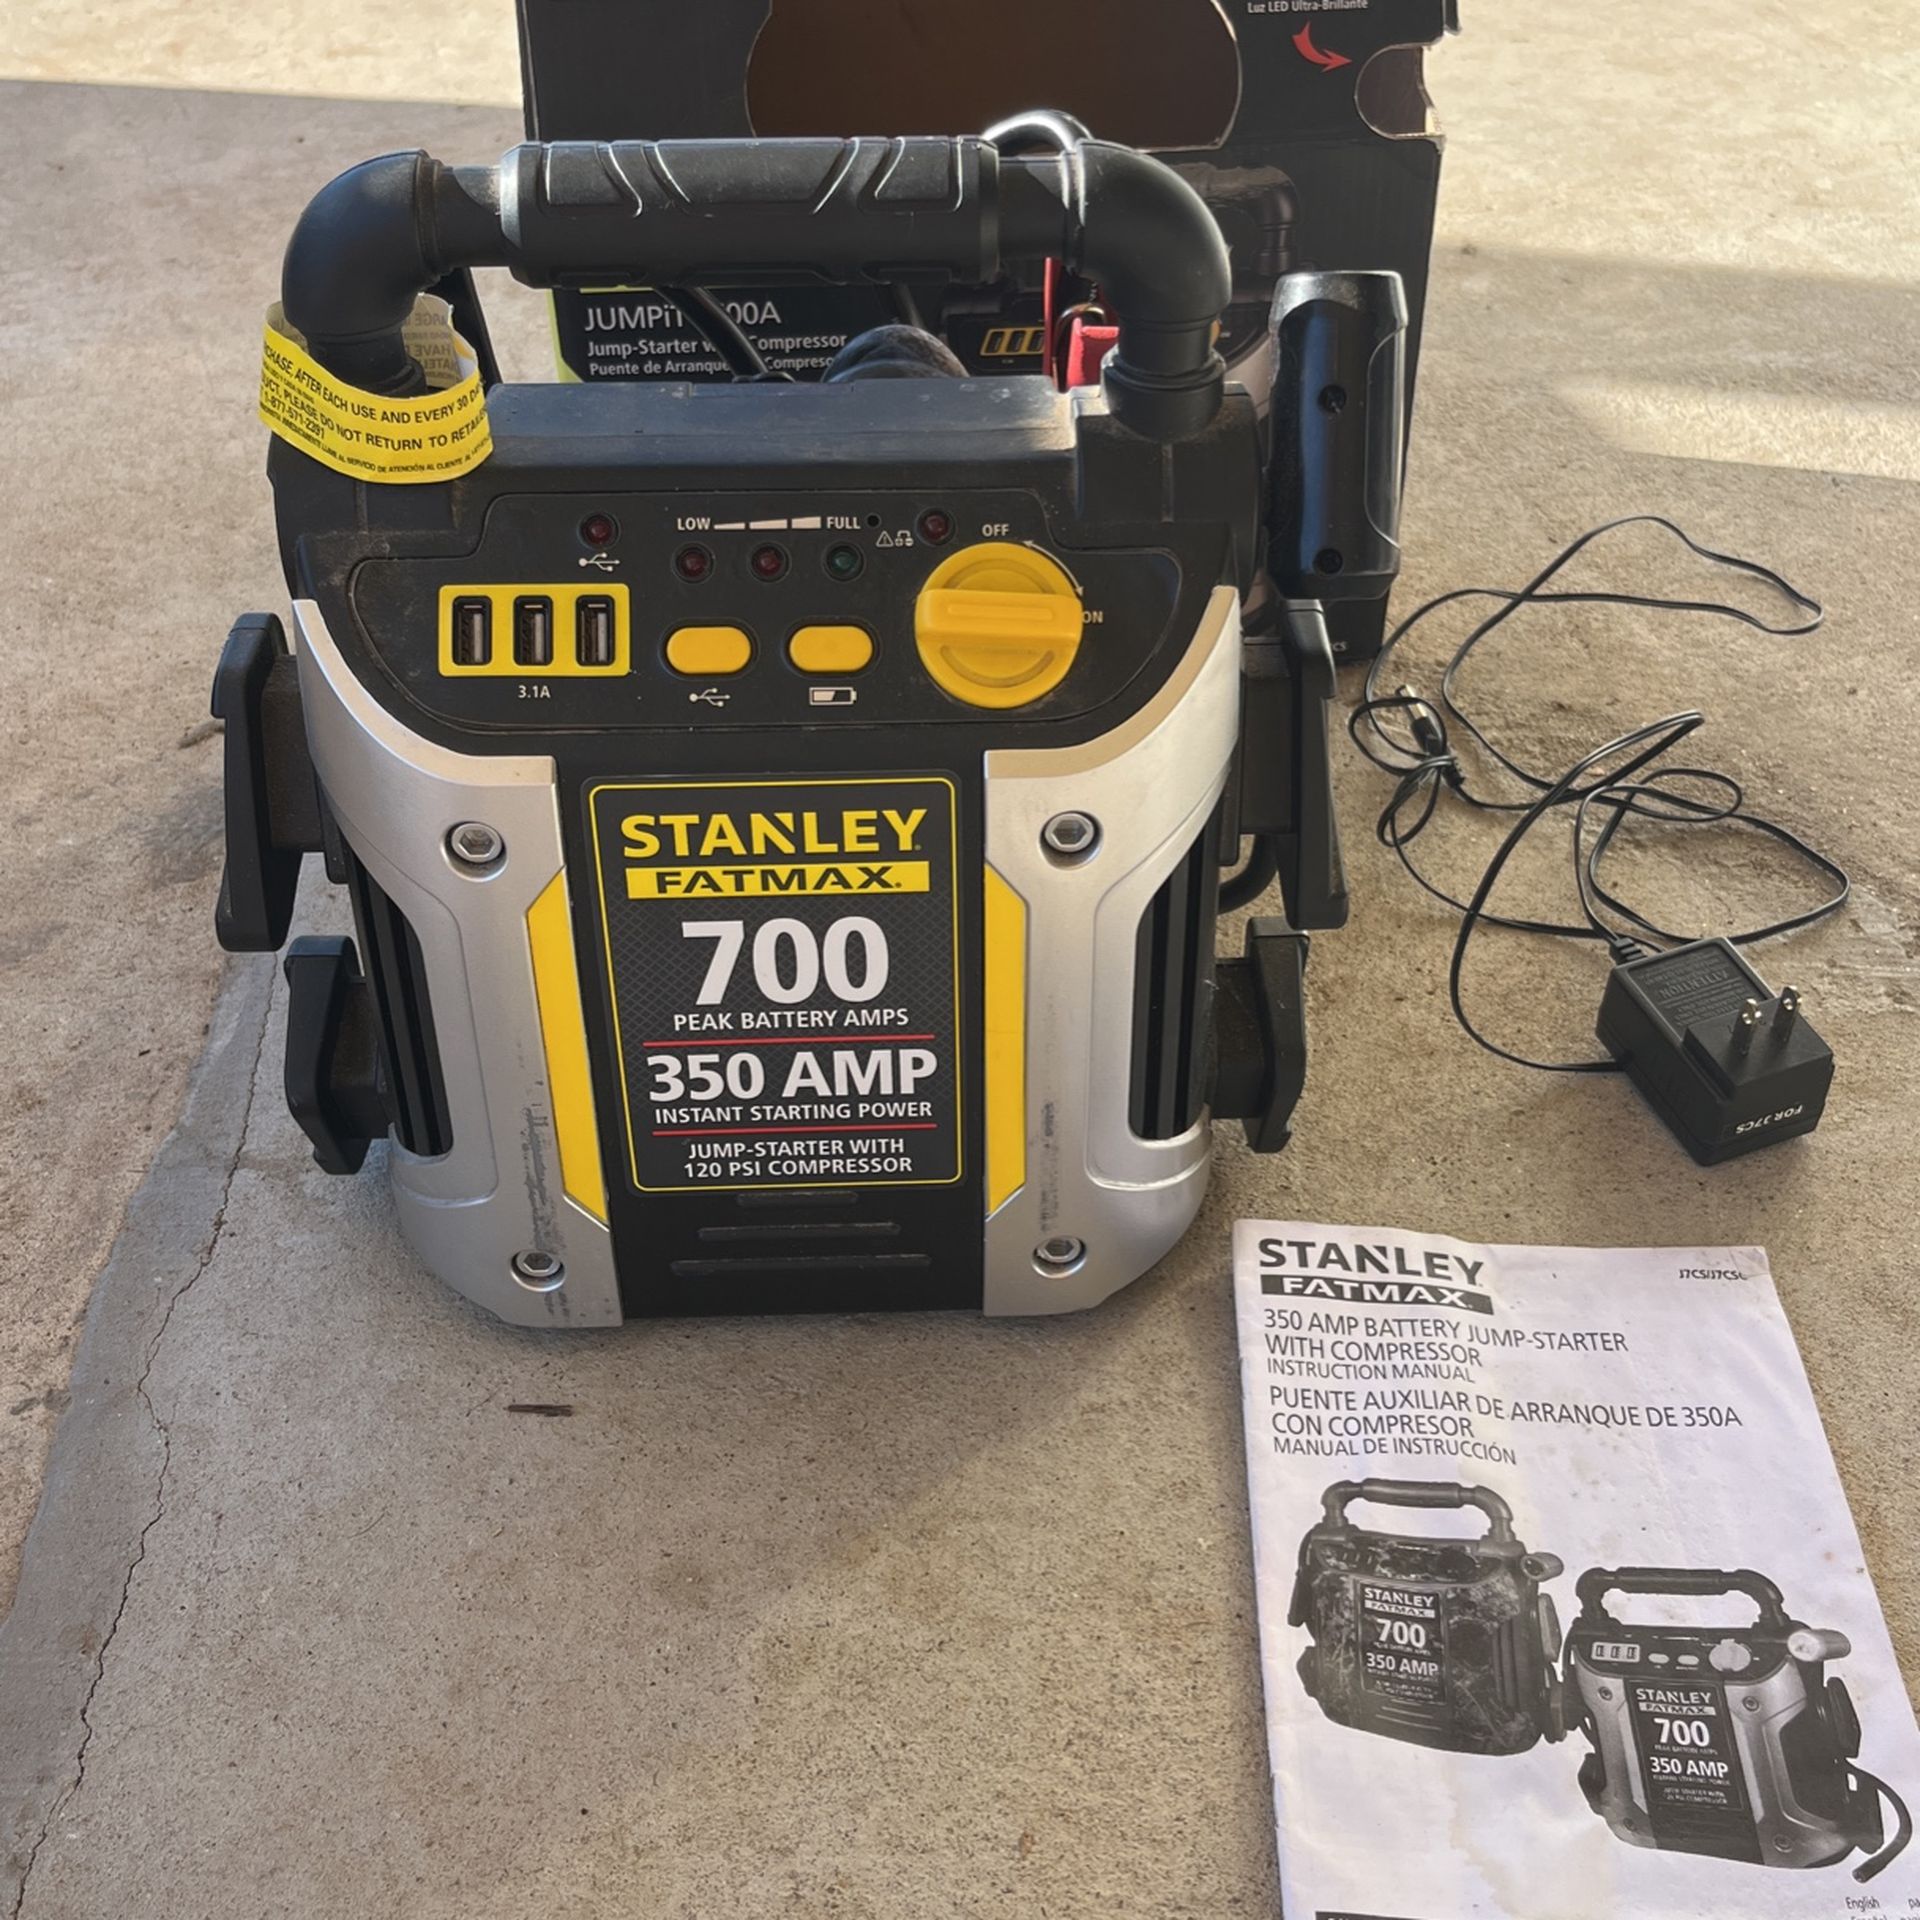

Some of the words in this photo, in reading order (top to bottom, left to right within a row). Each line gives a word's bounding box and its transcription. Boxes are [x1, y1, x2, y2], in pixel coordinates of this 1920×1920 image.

[1247, 2, 1266, 13] Luz
[1268, 1, 1289, 12] LED
[588, 340, 698, 358] Jump-Starter
[749, 335, 848, 354] ompressor
[590, 362, 640, 376] Puente
[643, 360, 662, 374] de
[295, 368, 322, 396] AFTER
[322, 386, 348, 412] EACH
[351, 402, 377, 420] USE
[381, 410, 411, 424] AND
[415, 402, 455, 424] EVERY
[457, 395, 469, 411] 30
[335, 423, 362, 442] NOT
[365, 432, 423, 451] RETURN
[428, 434, 448, 448] TO
[677, 517, 711, 531] LOW
[826, 516, 861, 530] FULL
[982, 523, 1010, 537] OFF
[1082, 610, 1104, 624] ON
[518, 685, 551, 699] 3.1A
[620, 808, 928, 858] STANLEY
[656, 866, 893, 894] FATMAX
[681, 915, 890, 1006] 700
[673, 1012, 734, 1031] PEAK
[741, 1009, 838, 1030] BATTERY
[844, 1008, 909, 1027] AMPS
[646, 1052, 766, 1102] 350
[781, 1048, 938, 1098] AMP
[655, 1106, 743, 1124] INSTANT
[750, 1103, 852, 1121] STARTING
[858, 1101, 933, 1119] POWER
[1775, 1104, 1804, 1122] FOR
[688, 1140, 845, 1160] JUMP-STARTER
[849, 1138, 905, 1155] WITH
[684, 1161, 723, 1178] 120
[729, 1161, 761, 1177] PSI
[768, 1158, 913, 1176] COMPRESSOR
[1258, 1238, 1484, 1287] STANLEY
[1282, 1277, 1467, 1308] FATMAX
[1264, 1308, 1303, 1330] 350
[1307, 1312, 1359, 1336] AMP
[1364, 1318, 1461, 1340] BATTERY
[1467, 1324, 1629, 1351] JUMP-STARTER
[1264, 1333, 1325, 1360] WITH
[1330, 1341, 1484, 1368] COMPRESSOR
[1267, 1358, 1387, 1380] INSTRUCTION
[1392, 1364, 1476, 1384] MANUAL
[1269, 1386, 1358, 1411] PUENTE
[1363, 1390, 1472, 1413] AUXILIAR
[1475, 1395, 1506, 1420] DE
[1510, 1401, 1642, 1429] ARRANQUE
[1646, 1406, 1678, 1427] DE
[1682, 1406, 1743, 1427] 350A
[1272, 1412, 1323, 1436] CON
[1328, 1415, 1475, 1438] COMPRESOR
[1273, 1436, 1360, 1457] MANUAL
[1363, 1438, 1389, 1455] DE
[1393, 1438, 1517, 1466] INSTRUCCIÓN
[1364, 1587, 1434, 1608] STANLEY
[1376, 1618, 1426, 1648] 700
[1366, 1652, 1396, 1670] 350
[1399, 1658, 1439, 1676] AMP
[1636, 1688, 1711, 1704] STANLEY
[1653, 1717, 1710, 1747] 700
[1650, 1756, 1682, 1774] 350
[1686, 1760, 1728, 1778] AMP
[1845, 1896, 1880, 1912] English
